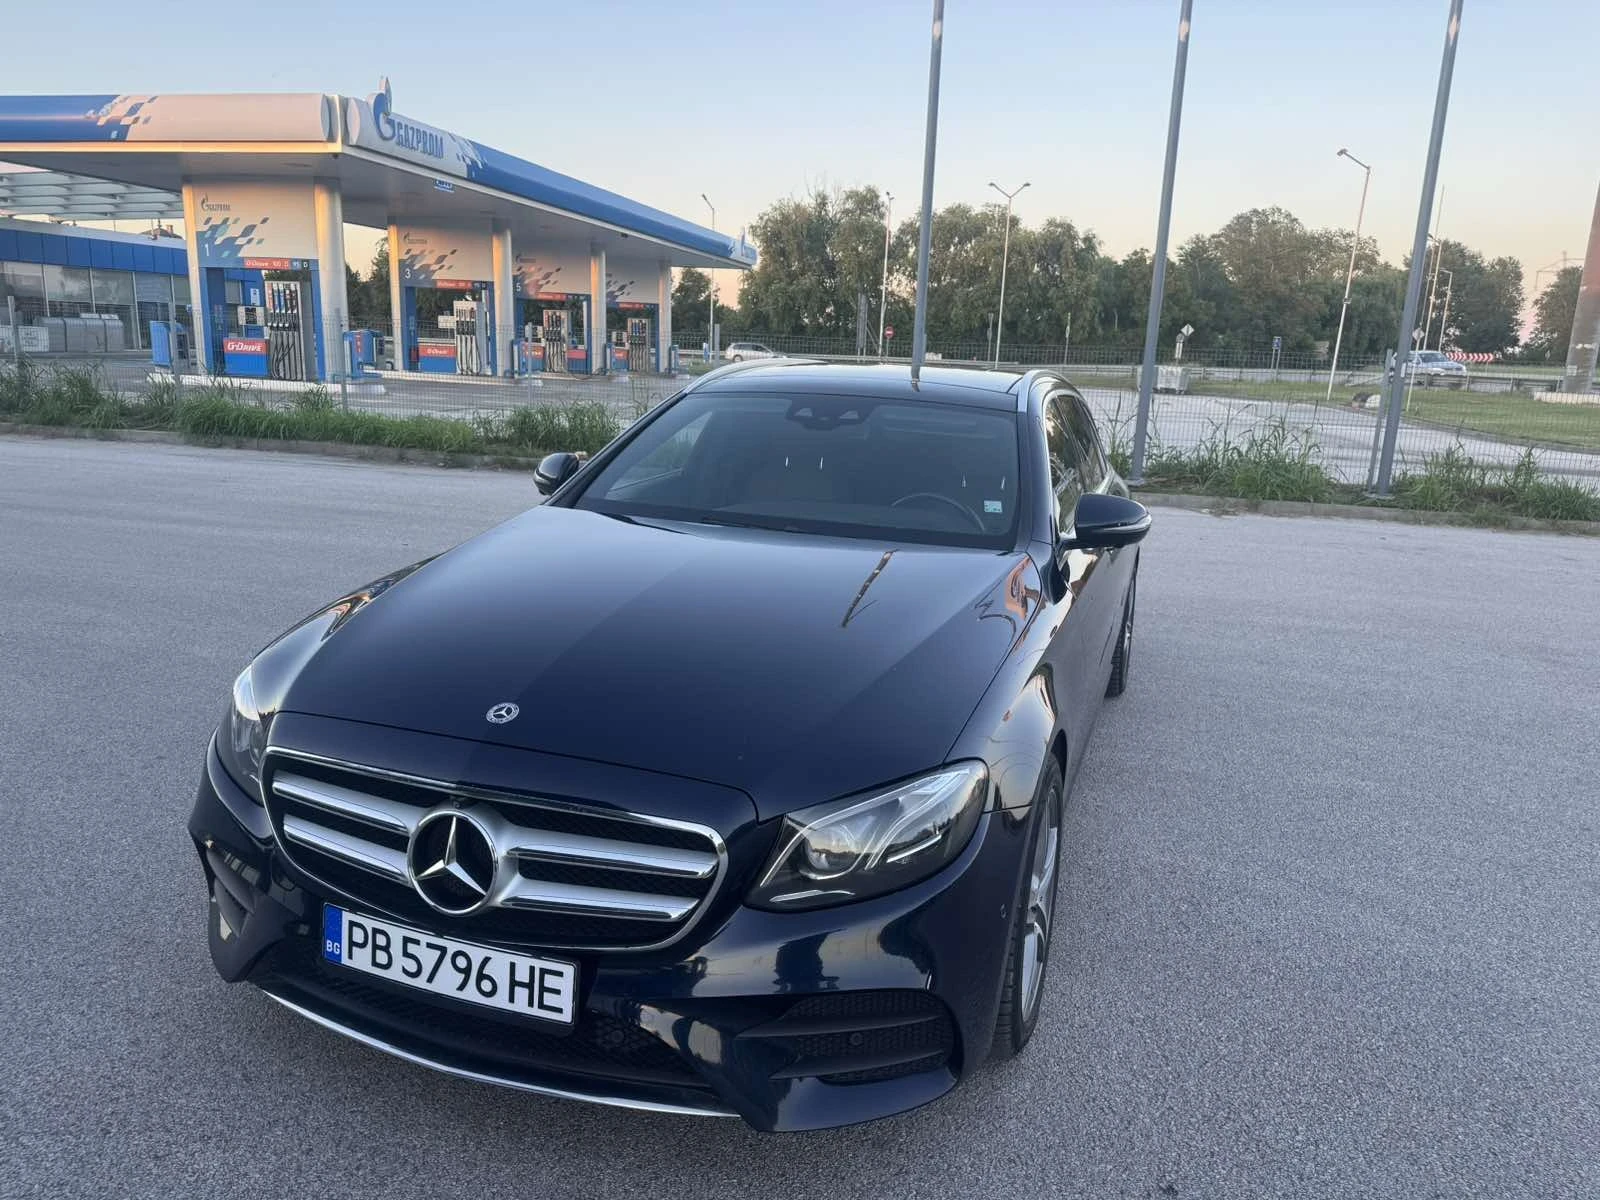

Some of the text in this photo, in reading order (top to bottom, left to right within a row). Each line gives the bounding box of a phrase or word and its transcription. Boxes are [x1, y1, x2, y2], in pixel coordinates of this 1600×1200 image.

[396, 121, 444, 160] GAZPROM
[204, 243, 210, 257] 1
[404, 268, 412, 279] 3
[326, 940, 340, 955] BG
[348, 919, 564, 1014] PB 5796 HE
